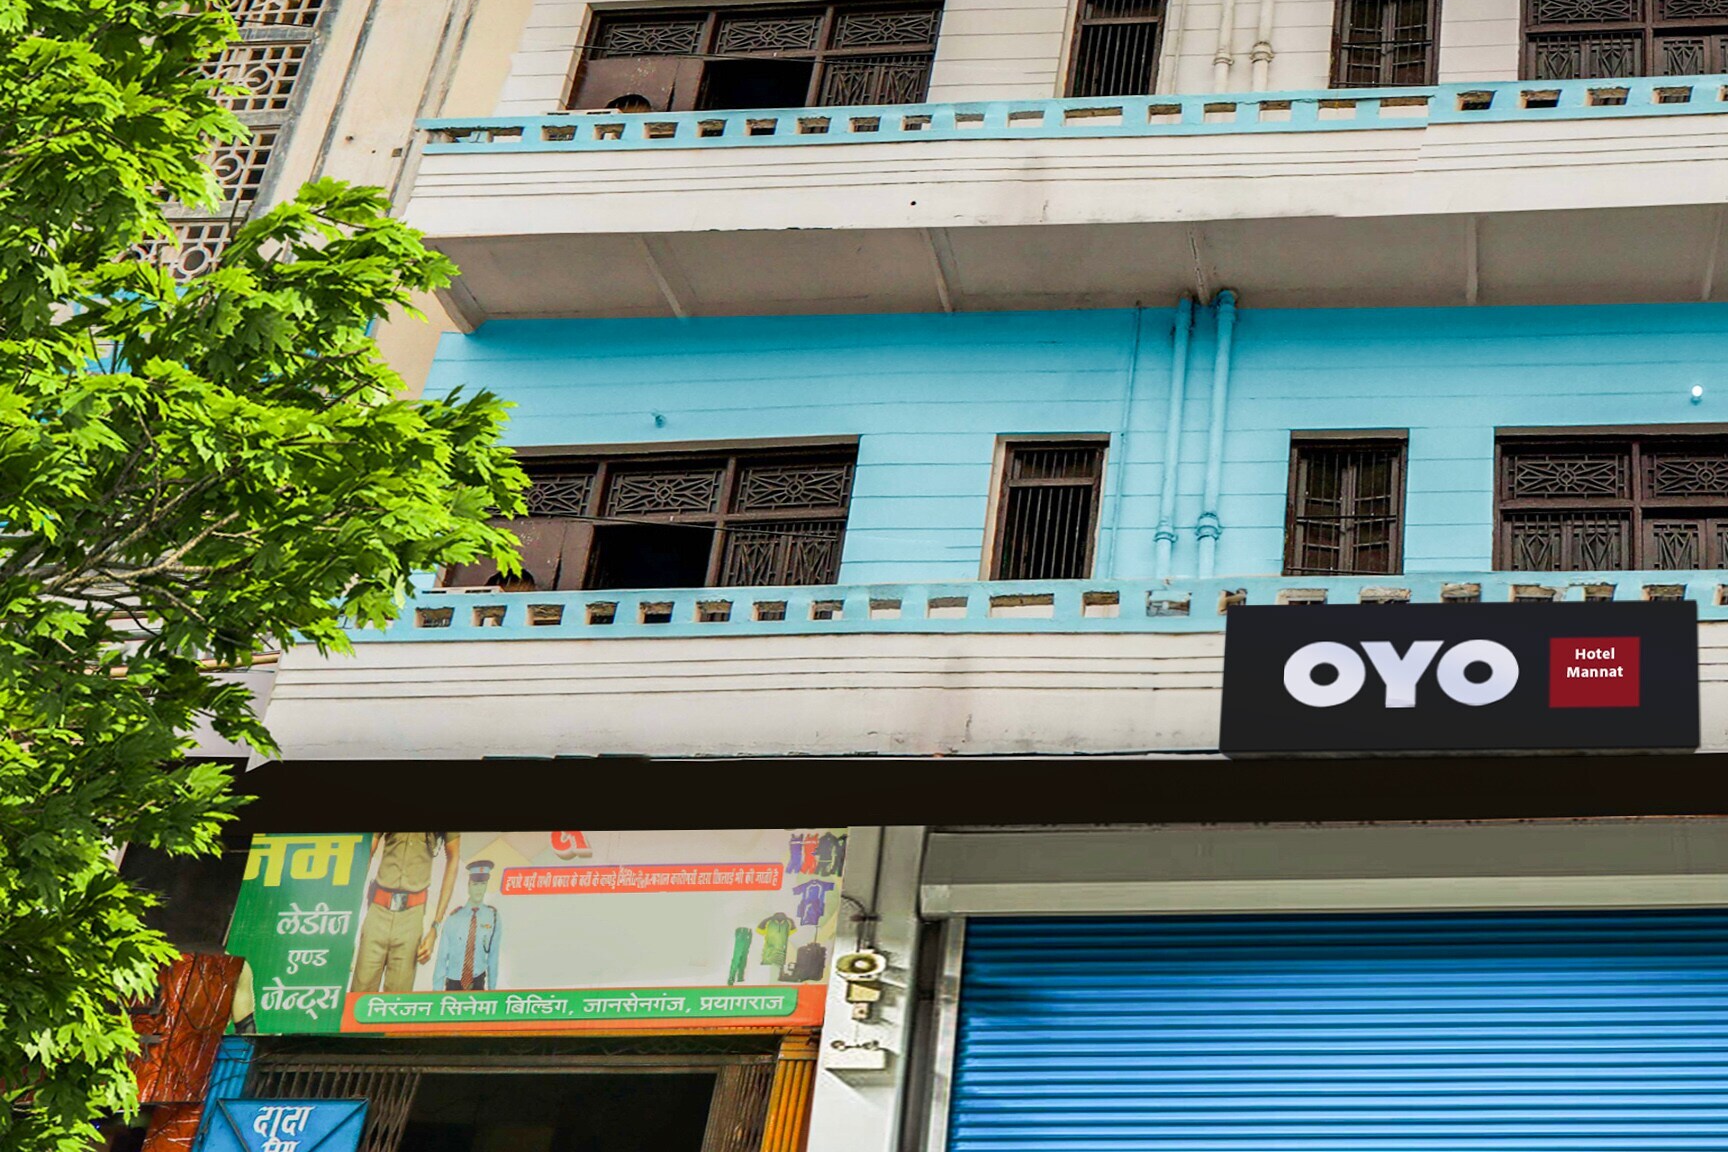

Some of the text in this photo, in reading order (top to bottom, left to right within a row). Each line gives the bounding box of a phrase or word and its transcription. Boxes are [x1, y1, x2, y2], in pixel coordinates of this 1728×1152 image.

[1574, 647, 1616, 661] Hotel
[1283, 639, 1519, 708] OYO
[1566, 665, 1624, 679] Mannat
[276, 902, 353, 935] लेडीज
[286, 949, 330, 975] एण्ड
[367, 993, 784, 1017] निरंजन सिनेमा बिल्डिंग, जानसेनगंज, प्रयागराज
[253, 1105, 316, 1138] दादा
